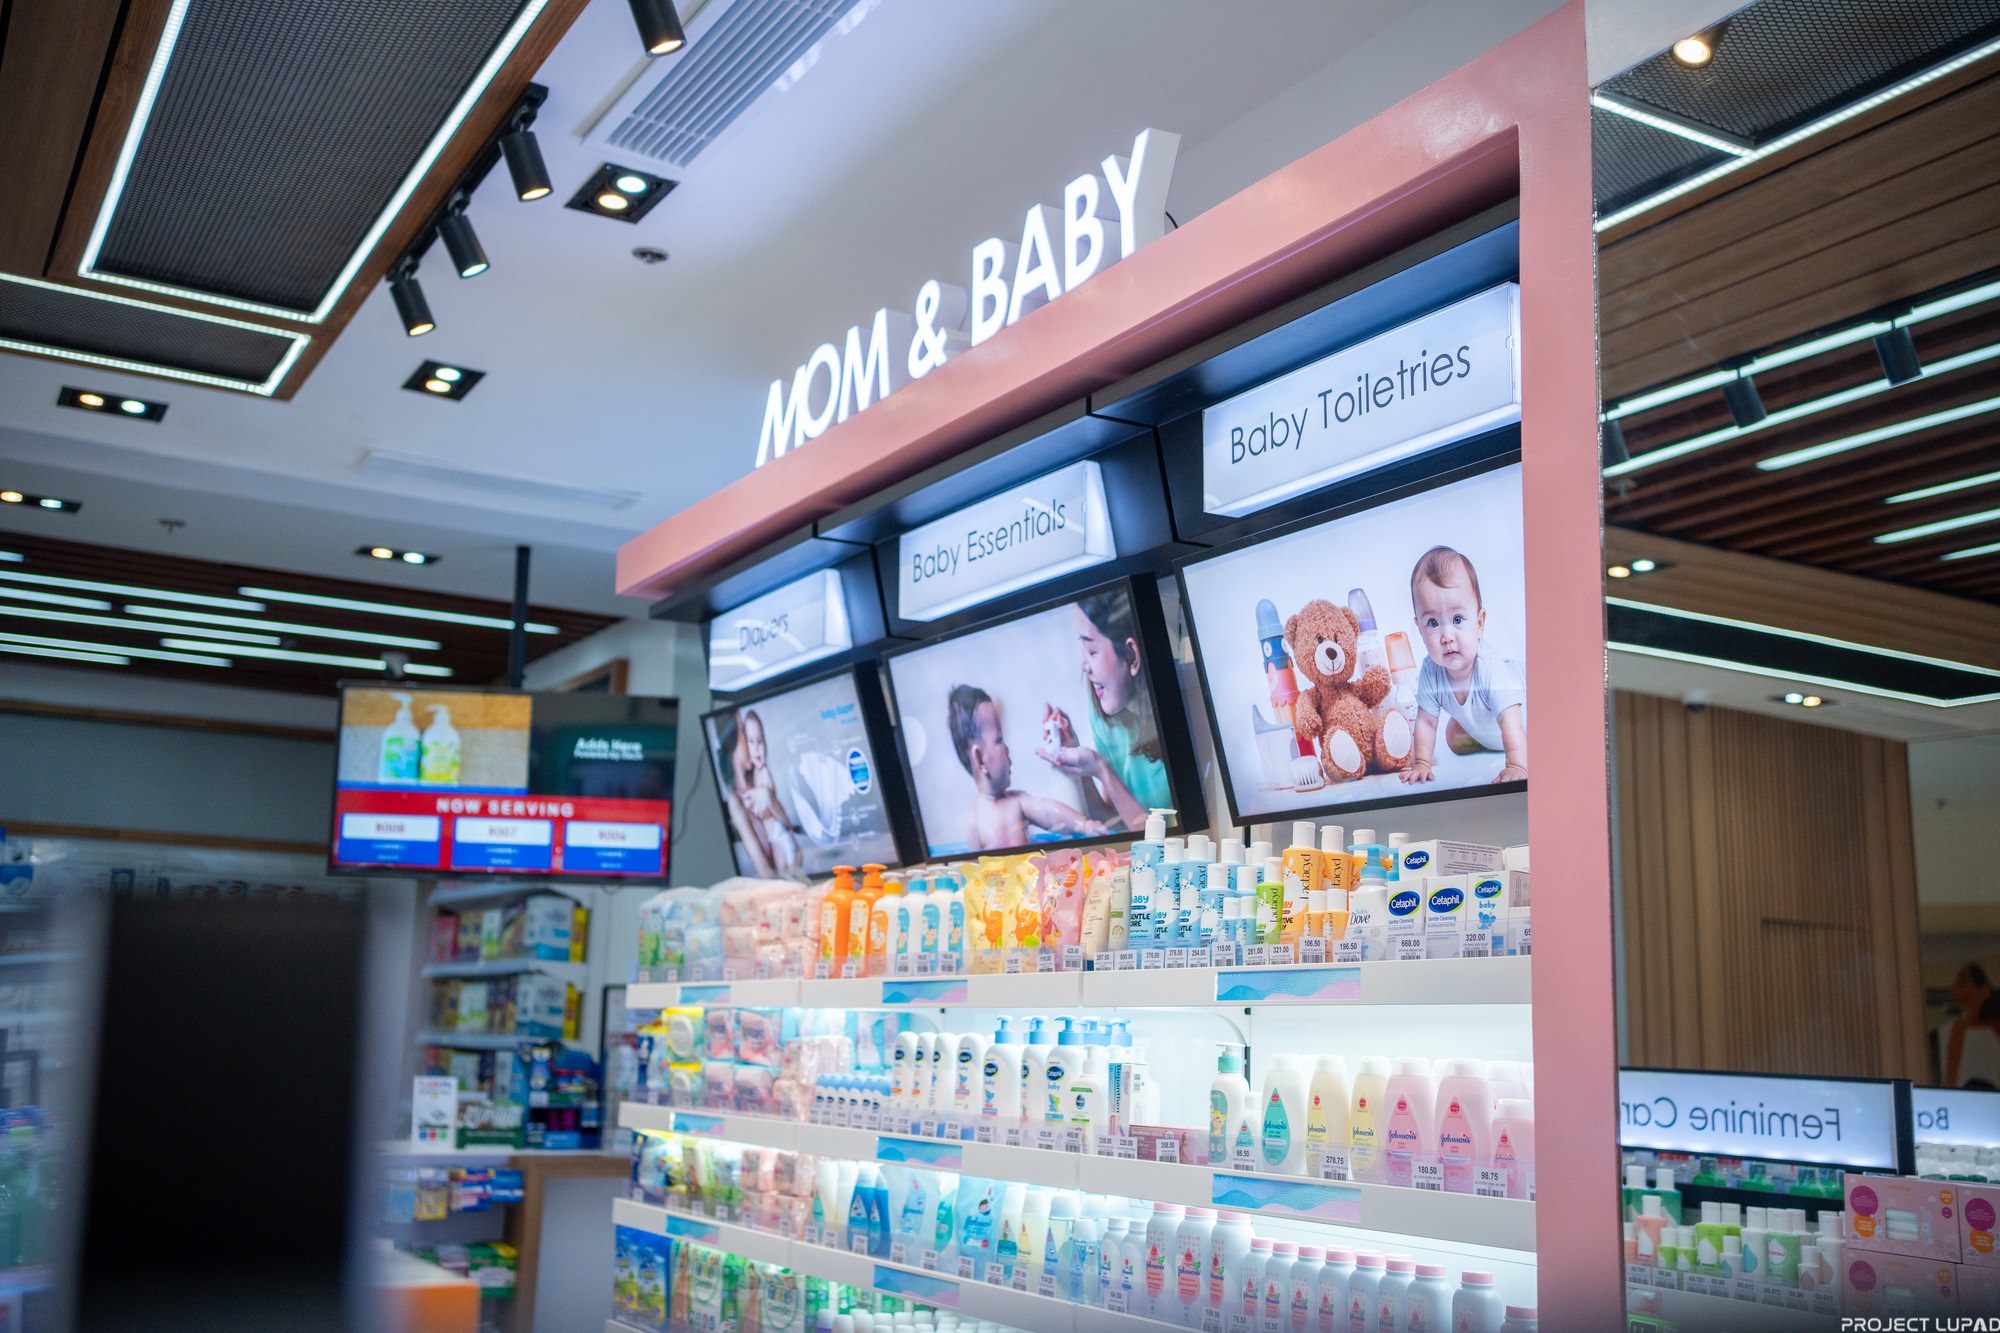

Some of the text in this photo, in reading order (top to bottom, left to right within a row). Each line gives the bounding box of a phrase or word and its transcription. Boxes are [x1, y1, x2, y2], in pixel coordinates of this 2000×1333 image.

[755, 127, 1155, 468] MOM & BABY
[1231, 345, 1471, 464] Baby Toiletries
[913, 499, 1066, 583] Baby Essentials
[739, 611, 789, 652] Diapers
[436, 798, 575, 818] NOW SERVING
[1405, 854, 1427, 865] Cetaphil
[1477, 884, 1499, 895] Cetaphil
[1391, 897, 1417, 909] Cetaphil
[1431, 894, 1460, 906] Cetaphil
[1479, 901, 1496, 910] baby
[1350, 912, 1371, 926] Dove
[1304, 939, 1320, 947] 106.50
[1401, 939, 1420, 947] 668.00
[1465, 933, 1486, 942] 320.00
[1339, 942, 1357, 950] 196.50
[1326, 1155, 1344, 1165] 278.75
[1418, 1165, 1437, 1175] 180.50
[1480, 1171, 1498, 1180] 98.75
